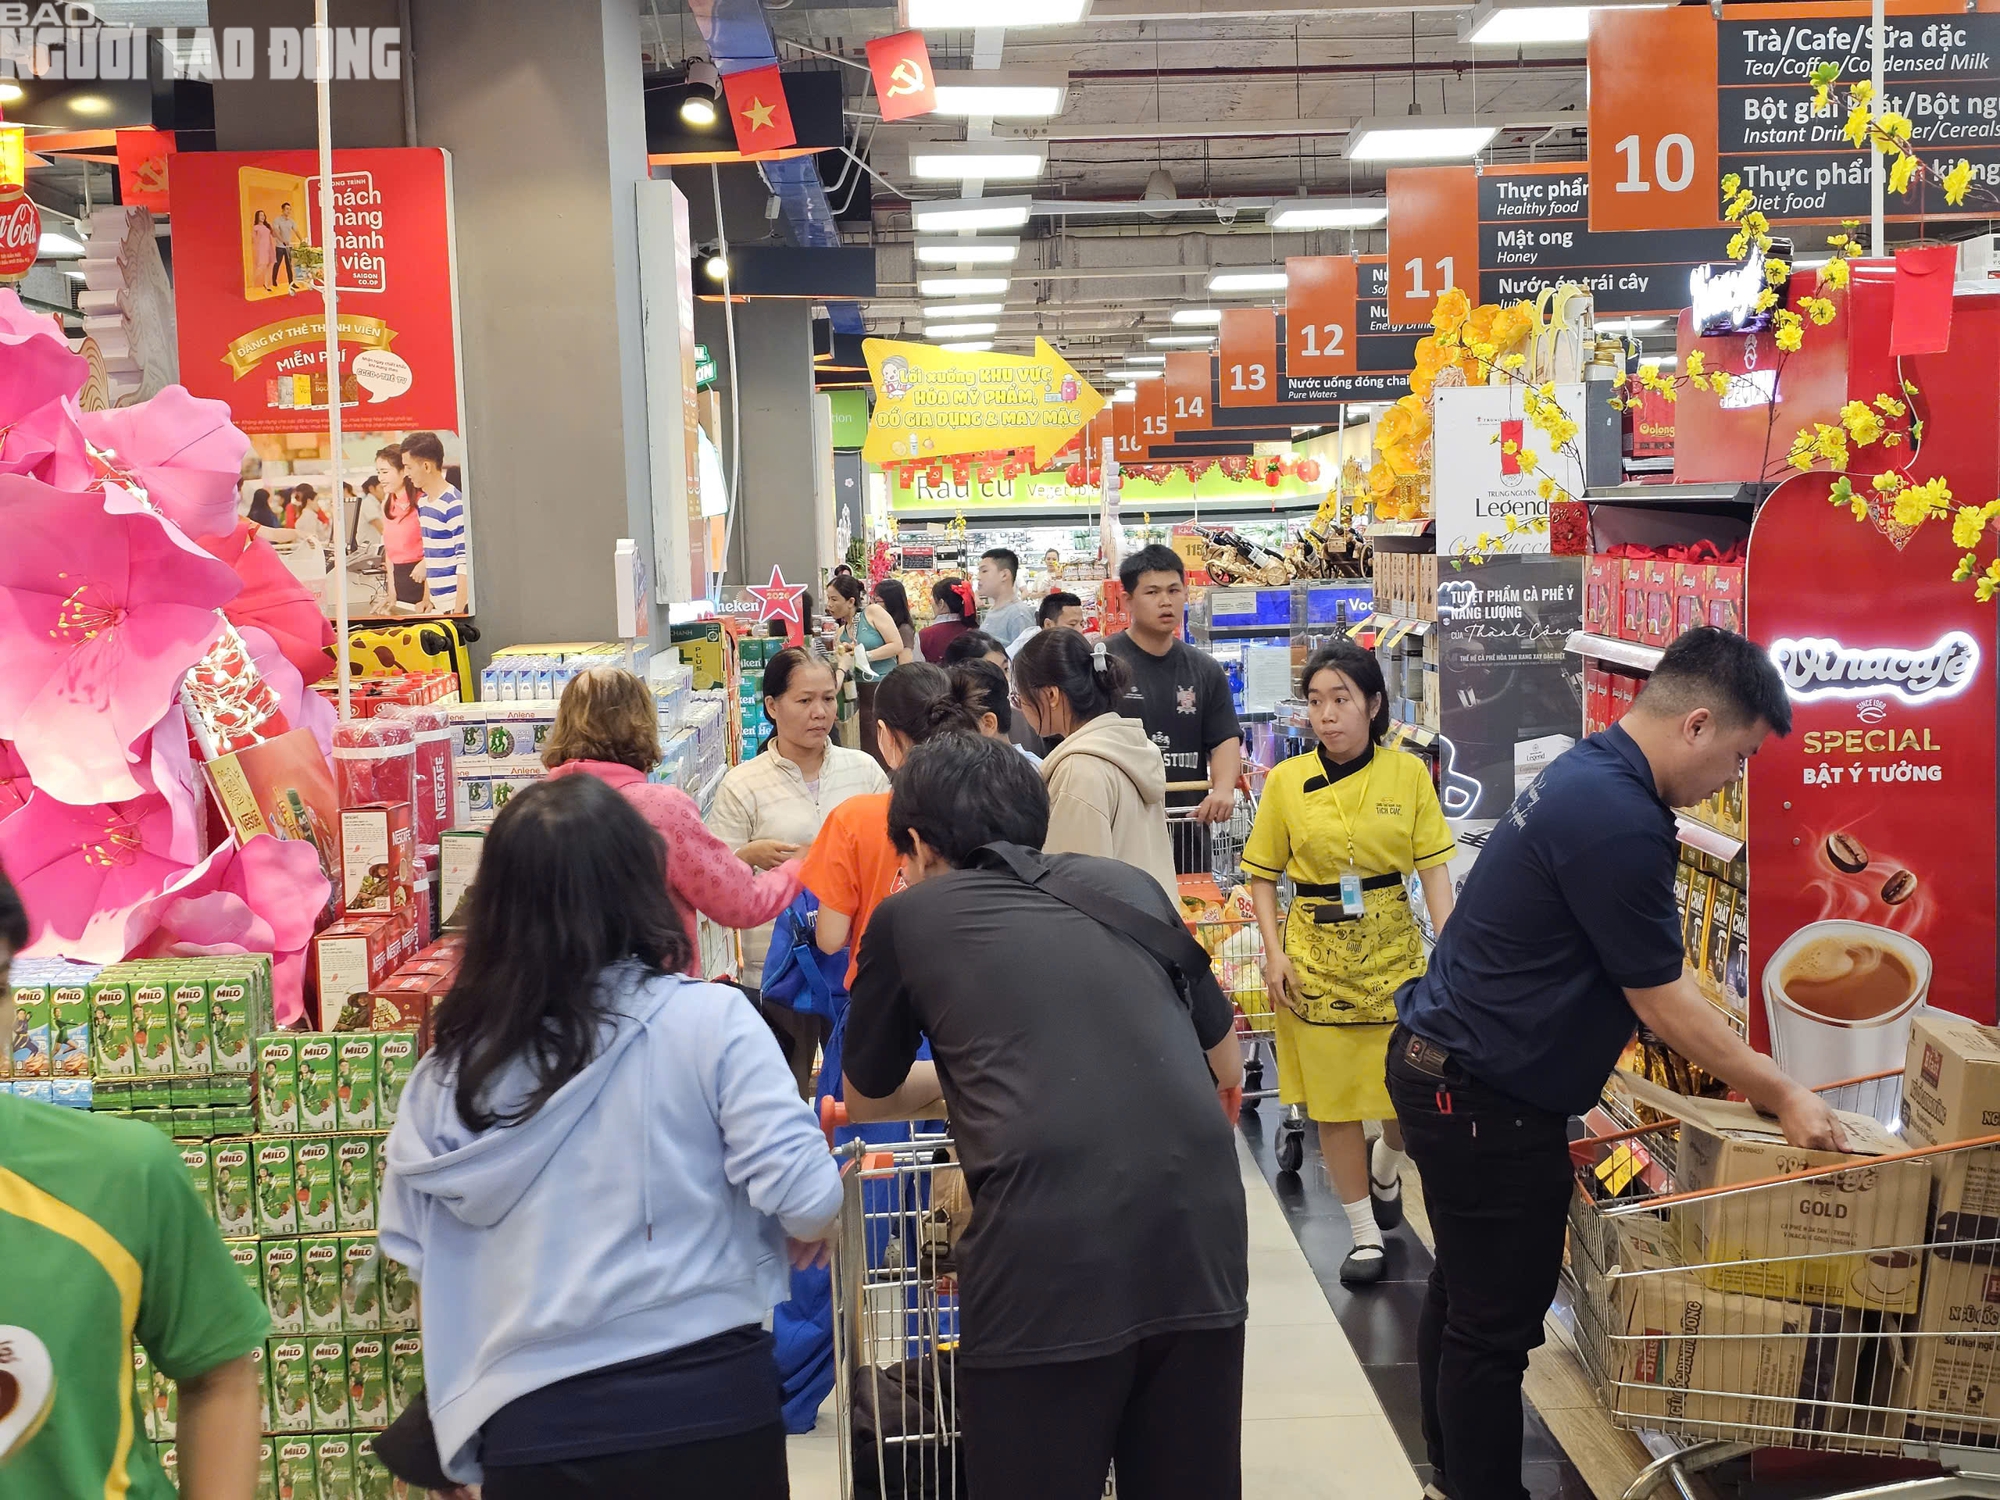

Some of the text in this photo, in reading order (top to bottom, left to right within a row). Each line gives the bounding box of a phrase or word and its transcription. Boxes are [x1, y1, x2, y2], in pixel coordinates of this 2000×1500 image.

[1921, 24, 1967, 51] đặc
[1950, 53, 1989, 70] Milk
[1743, 96, 1788, 125] Bột
[1743, 126, 1805, 144] Instant
[1613, 134, 1696, 193] 10
[1743, 165, 1808, 195] Thực
[1496, 180, 1542, 203] Thực
[1496, 200, 1580, 217] Healthy food
[1784, 192, 1826, 212] food
[1497, 229, 1574, 250] Mật ong
[1497, 250, 1538, 265] Honey
[352, 272, 378, 280] SAIGON
[1404, 255, 1454, 298] 11
[1498, 275, 1550, 296] Nước
[1582, 274, 1613, 291] trái
[1618, 274, 1650, 294] cây
[236, 321, 382, 357] ĐĂNG KÝ THẺ VIÊN
[1300, 324, 1345, 356] 12
[276, 349, 316, 373] MIỄN
[898, 366, 923, 385] Lối
[925, 366, 975, 386] xuống
[978, 367, 1013, 384] KHU
[1229, 364, 1267, 391] 13
[1287, 375, 1409, 391] Nước uống đóng chai
[913, 387, 950, 407] HÓA
[1287, 389, 1338, 400] Pure Waters
[1174, 396, 1205, 418] 14
[903, 410, 933, 428] GIA
[936, 410, 983, 430] DỤNG
[1000, 410, 1040, 427] MAY
[1142, 415, 1168, 435] 15
[1639, 422, 1676, 438] Oolong
[1488, 490, 1510, 498] TRUNG
[1475, 497, 1550, 519] Legend
[766, 591, 790, 601] 2026
[1486, 584, 1520, 603] PHẨM
[1523, 585, 1539, 602] CÀ
[1541, 584, 1565, 601] PHÊ
[1566, 584, 1575, 601] Ý
[1484, 605, 1523, 622] LƯỢNG
[1778, 639, 1973, 692] Vinacafé
[507, 711, 536, 719] Anlene
[1803, 728, 1941, 754] SPECIAL
[510, 767, 541, 775] Anlene
[1803, 760, 1942, 789] BẬT Ý TƯỞNG
[17, 992, 41, 1001] MILO
[56, 992, 81, 1001] MILO
[98, 993, 122, 1002] MILO
[137, 991, 162, 1000] MILO
[176, 991, 201, 1000] MILO
[216, 989, 241, 998] MILO
[264, 1046, 289, 1058] MILO
[303, 1045, 328, 1056] MILO
[344, 1044, 369, 1055] MILO
[383, 1043, 408, 1055] MILO
[262, 1150, 286, 1161] MILO
[301, 1147, 326, 1157] MILO
[341, 1145, 366, 1156] MILO
[219, 1154, 243, 1164] MILO
[1799, 1199, 1848, 1219] GOLD
[269, 1251, 293, 1261] MILO
[309, 1249, 333, 1259] MILO
[348, 1247, 372, 1257] MILO
[277, 1348, 301, 1358] MILO
[315, 1347, 339, 1357] MILO
[355, 1344, 379, 1355] MILO
[395, 1341, 419, 1352] MILO
[283, 1446, 308, 1456] MILO
[321, 1445, 346, 1455] MILO
